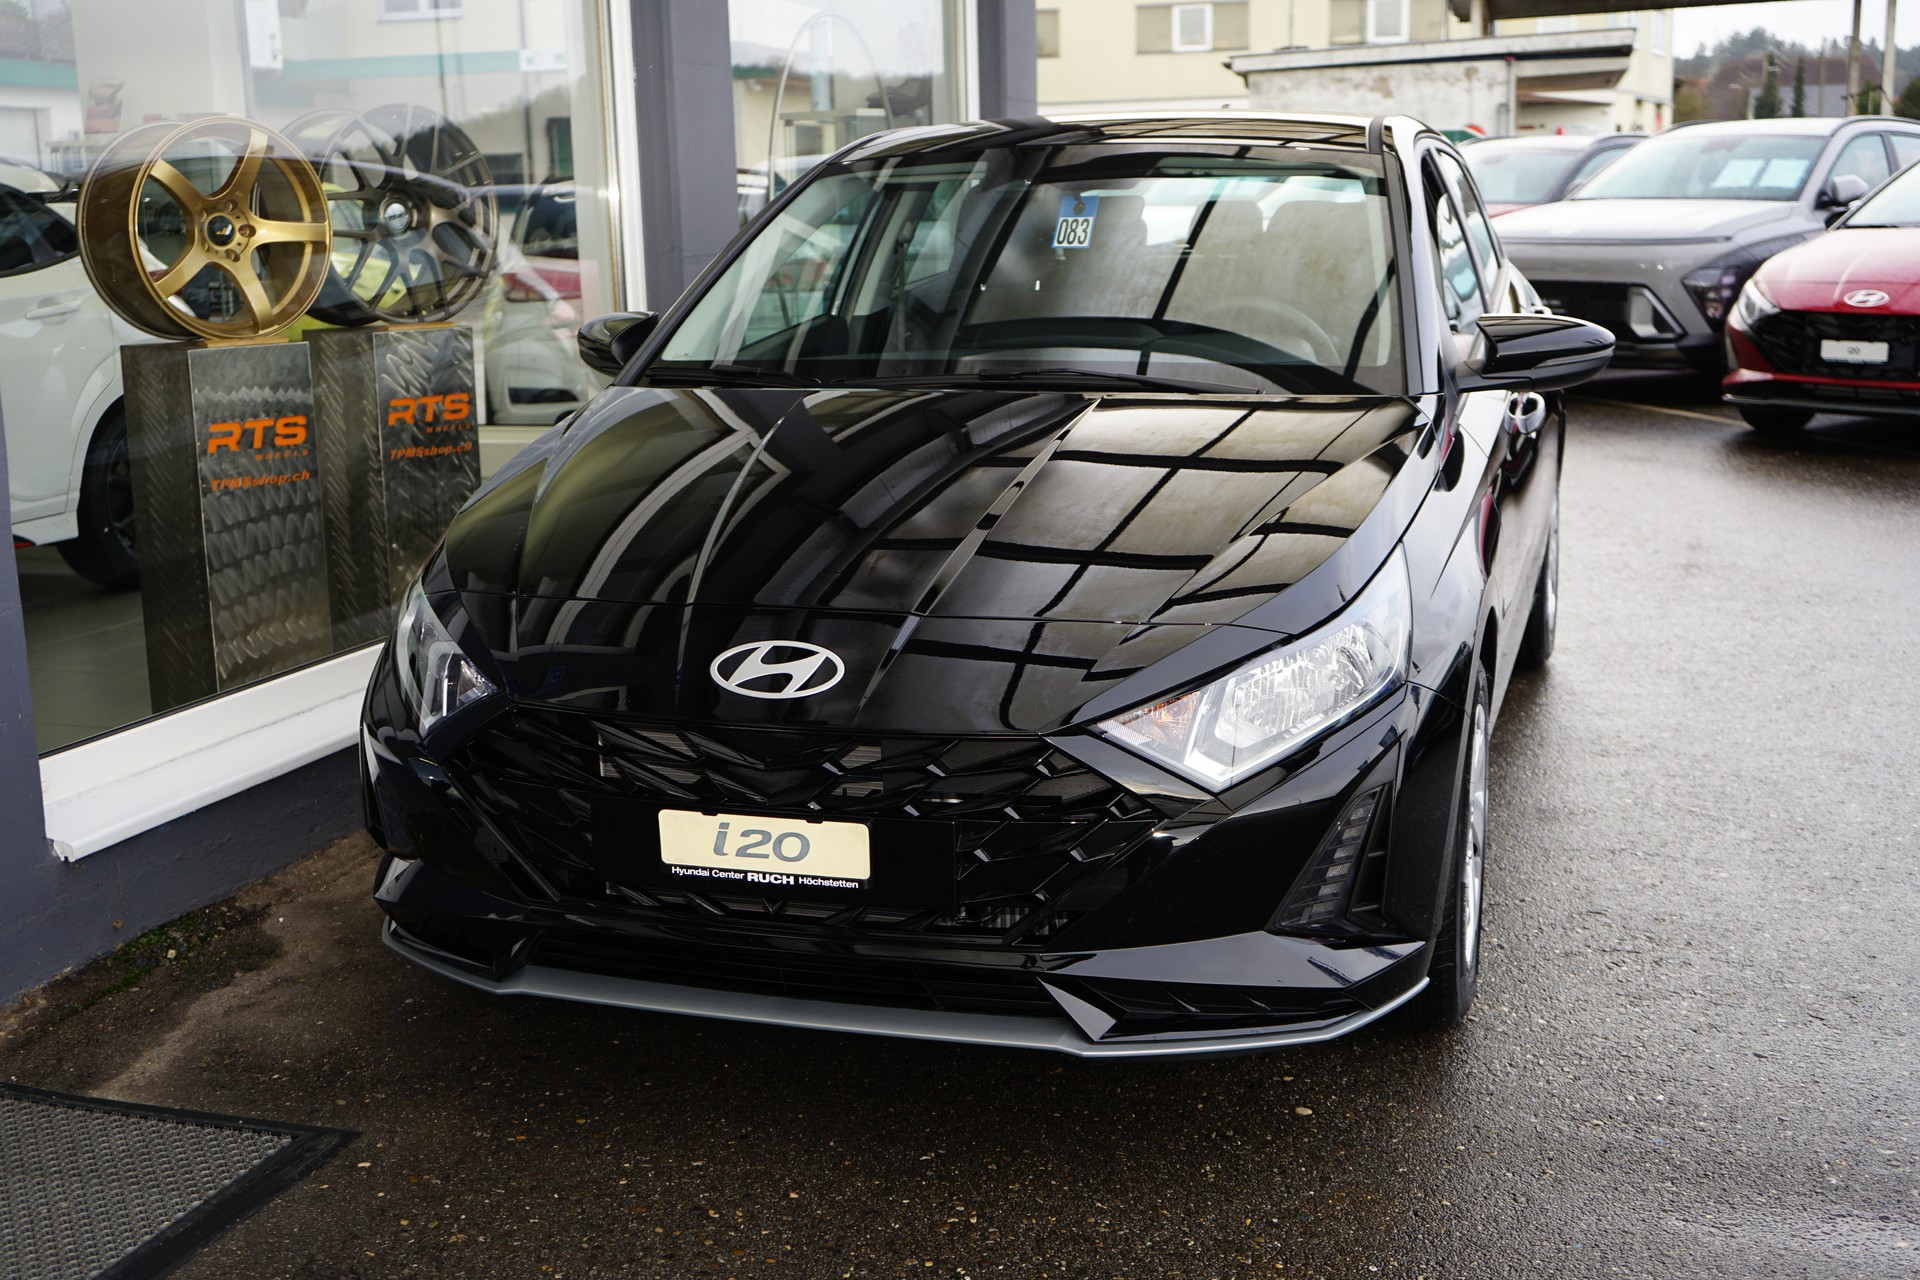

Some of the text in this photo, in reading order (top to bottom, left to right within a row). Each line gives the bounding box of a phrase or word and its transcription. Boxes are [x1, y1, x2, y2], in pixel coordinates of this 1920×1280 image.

[1056, 218, 1090, 245] 083
[388, 392, 470, 426] RTS
[207, 415, 307, 455] RTS
[210, 469, 310, 492] TPMSshop.ch
[713, 822, 811, 862] i20
[671, 865, 859, 889] Hyundai Center RUCH Höchstetten
